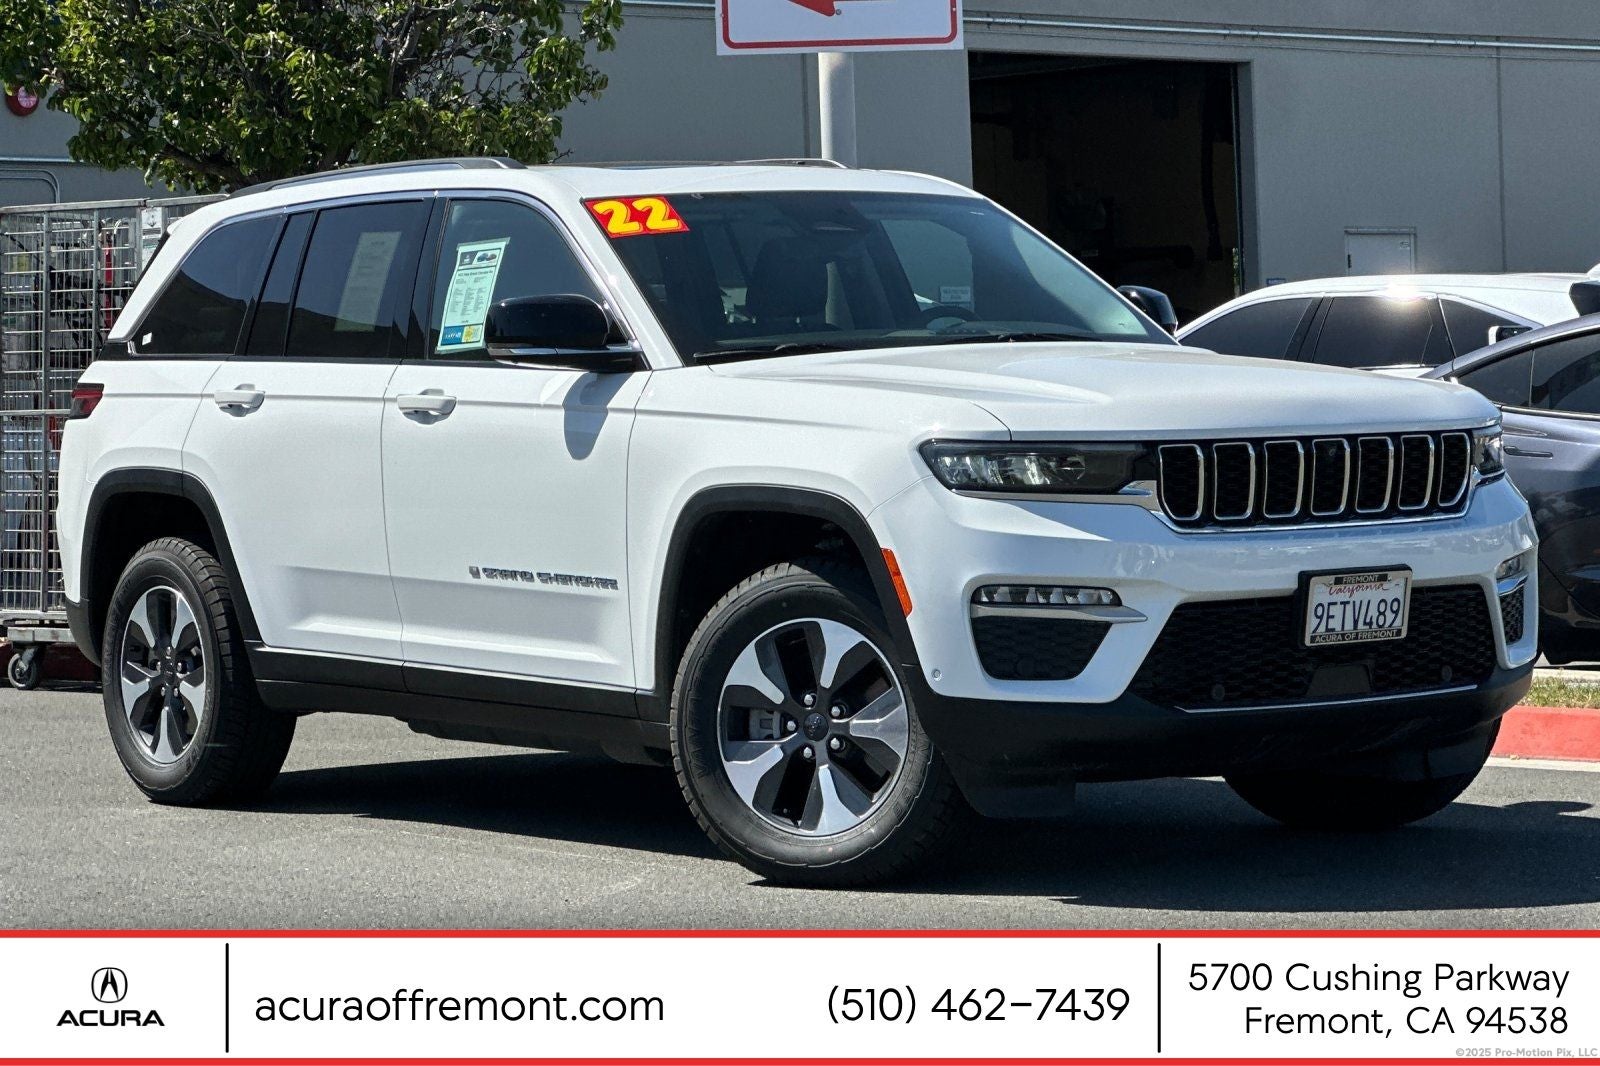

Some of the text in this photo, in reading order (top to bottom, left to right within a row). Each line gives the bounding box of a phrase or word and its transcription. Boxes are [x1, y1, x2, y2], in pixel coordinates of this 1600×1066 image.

[592, 197, 683, 235] 22
[1342, 574, 1379, 585] FREMONT
[1328, 582, 1389, 598] California
[1311, 597, 1401, 634] 9ETV489
[1315, 629, 1398, 643] ACURA OF FREMONT
